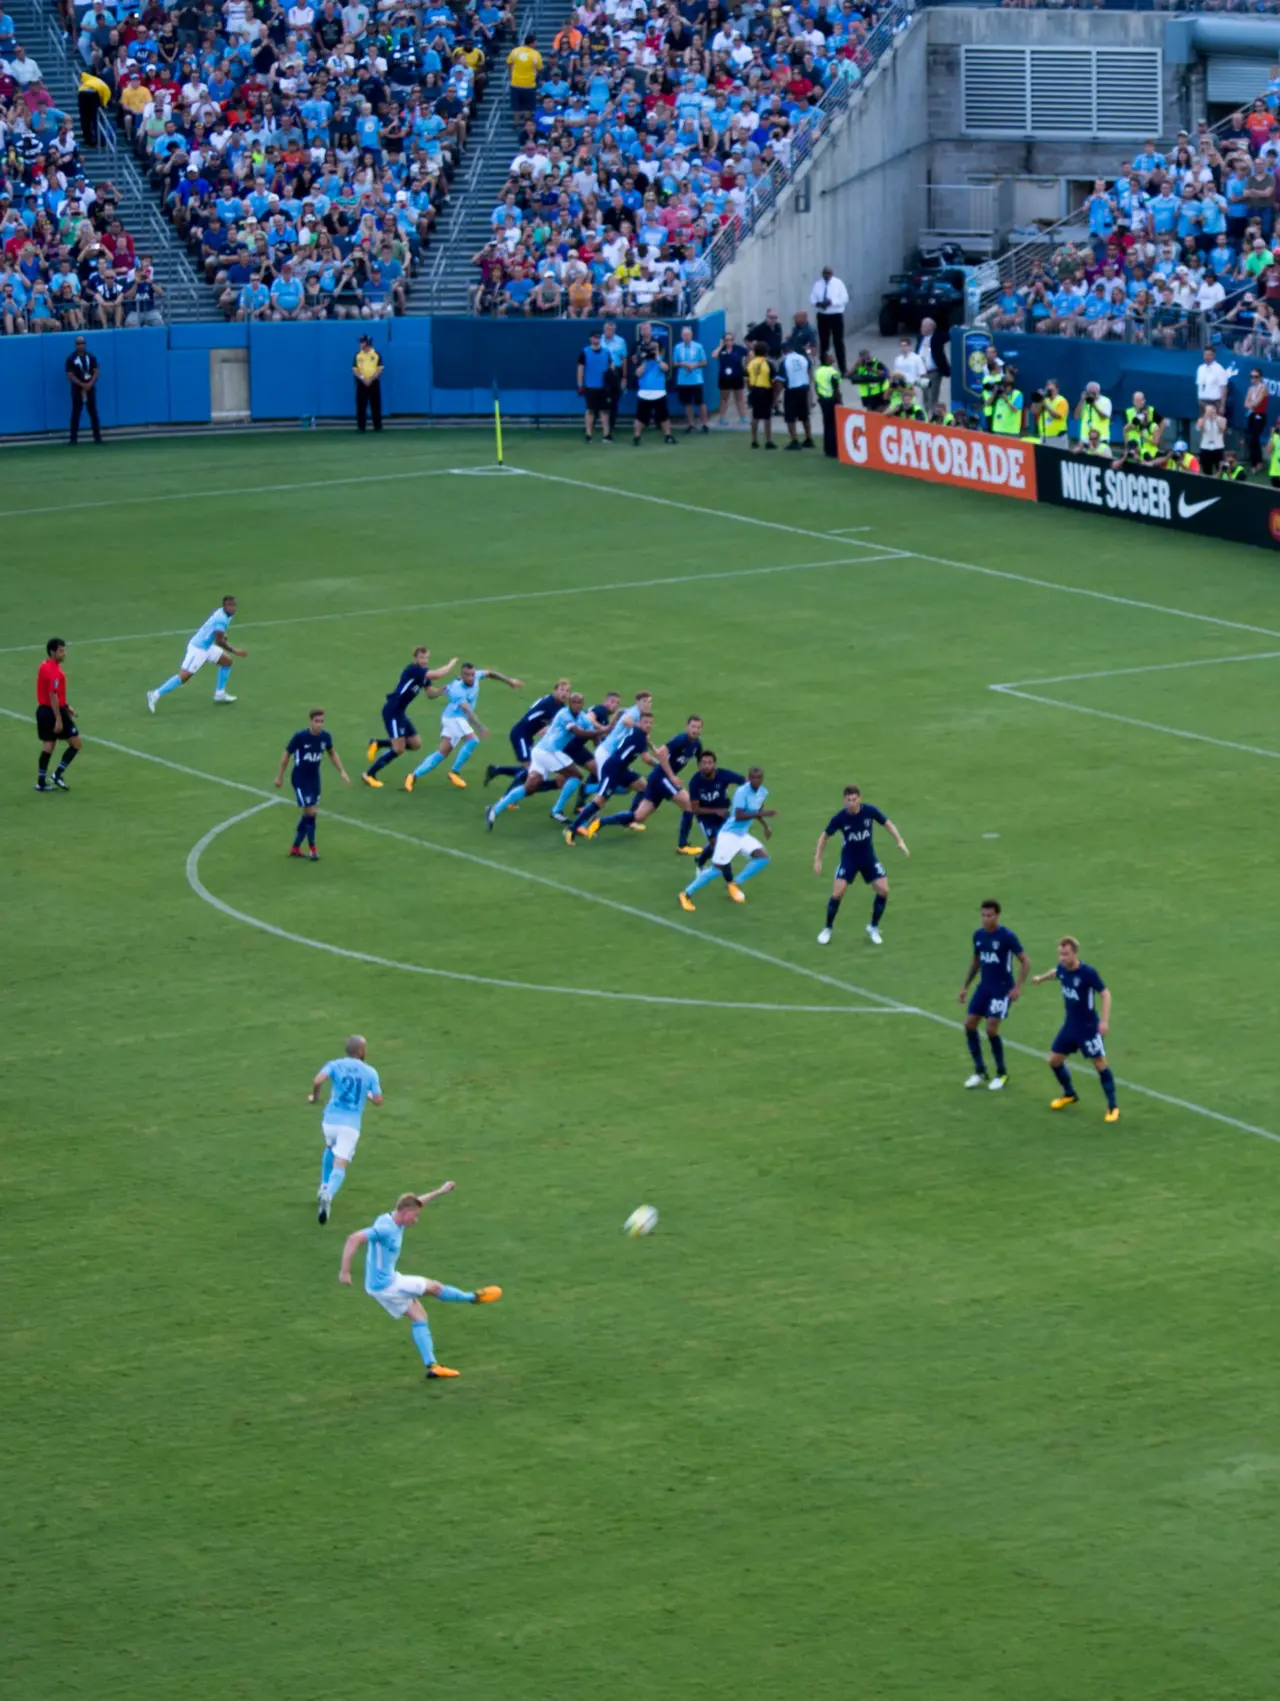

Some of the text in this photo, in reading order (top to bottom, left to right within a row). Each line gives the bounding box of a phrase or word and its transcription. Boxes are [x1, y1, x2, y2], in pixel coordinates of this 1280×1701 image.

[880, 425, 1026, 489] GATORADE
[1060, 460, 1172, 520] NIKE SOCCER
[848, 830, 871, 841] AIA
[340, 1076, 362, 1104] 21
